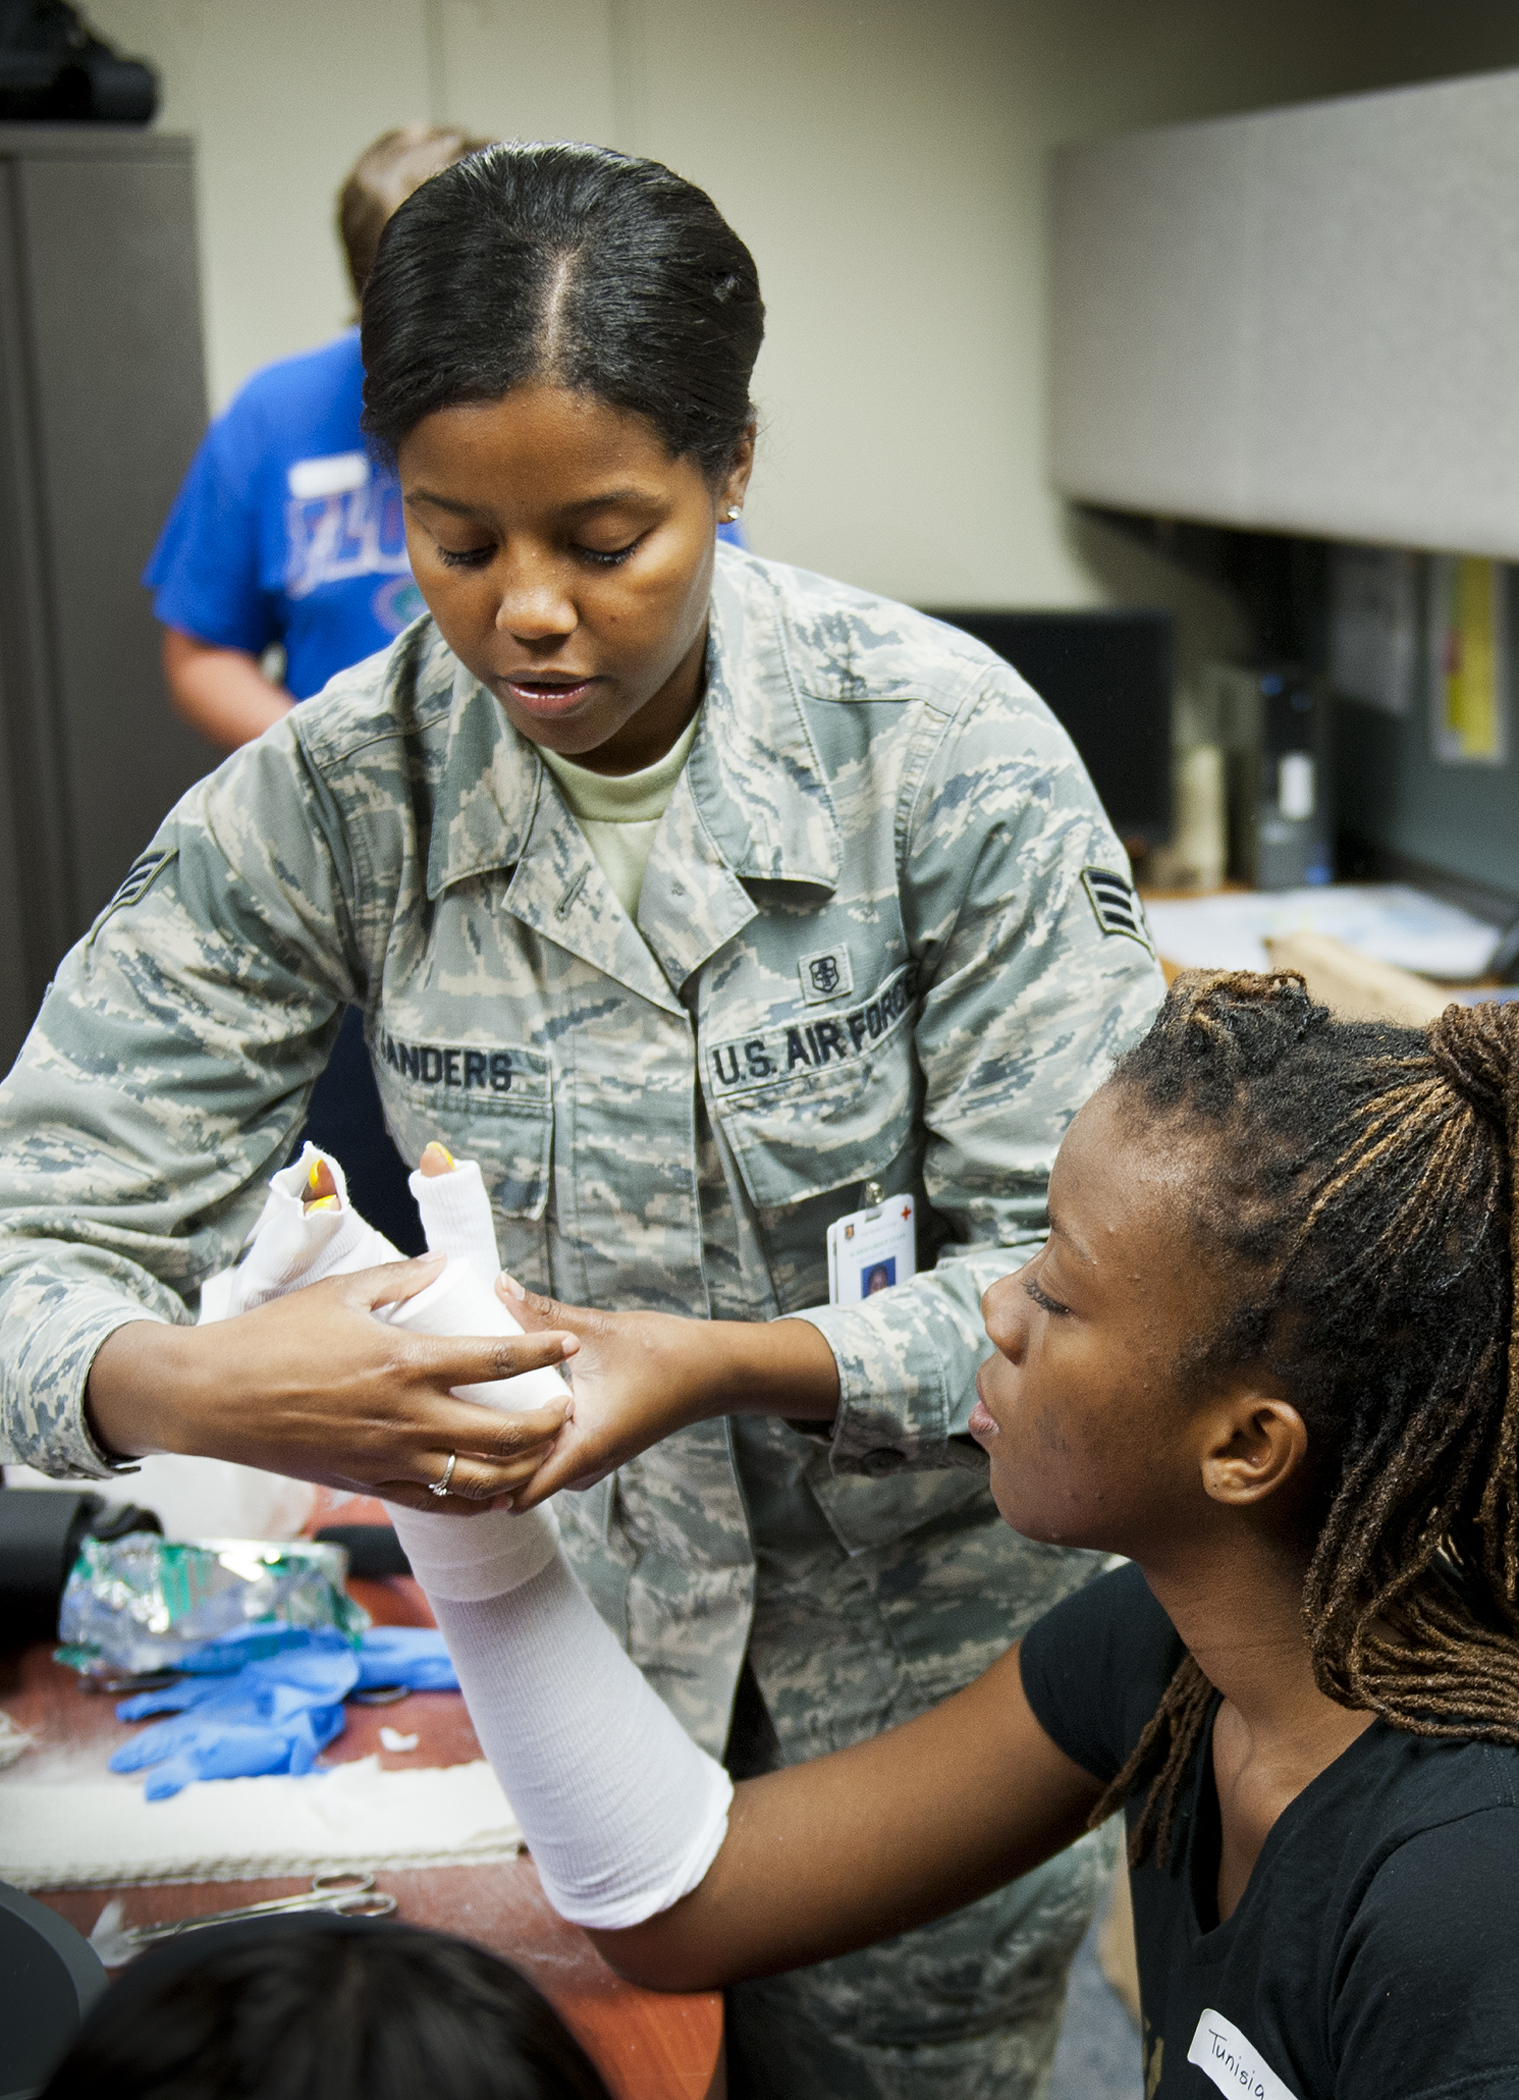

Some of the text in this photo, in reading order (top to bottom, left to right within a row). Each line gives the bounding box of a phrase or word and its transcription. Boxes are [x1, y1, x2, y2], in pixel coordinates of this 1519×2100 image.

[381, 1027, 512, 1091] ANDERS
[712, 1039, 777, 1085] U.S.
[786, 1021, 847, 1070] AIR
[1208, 2028, 1264, 2100] Tunisia
